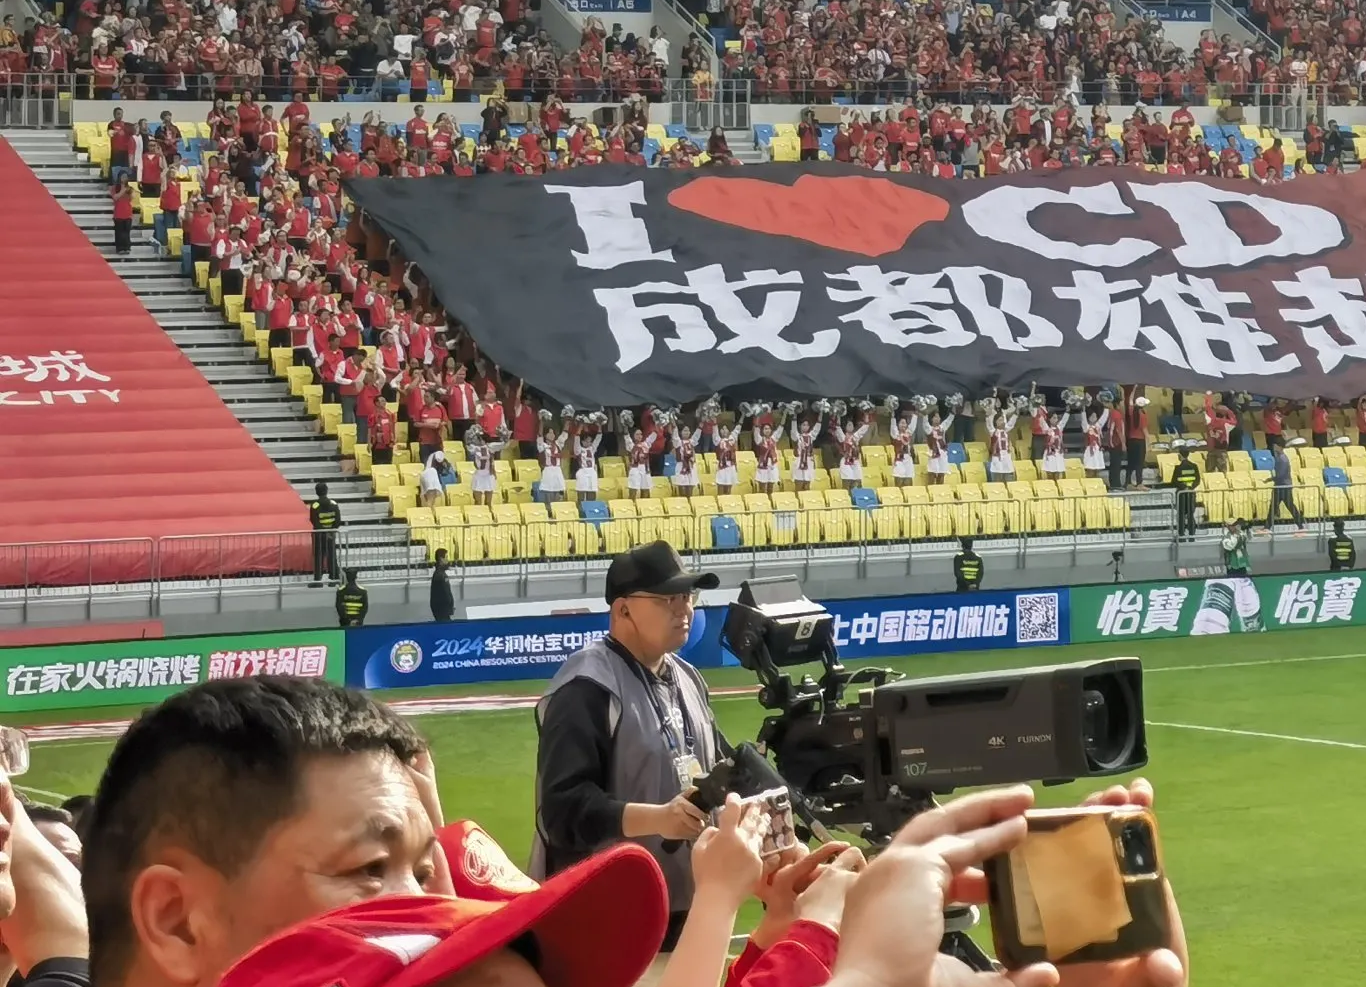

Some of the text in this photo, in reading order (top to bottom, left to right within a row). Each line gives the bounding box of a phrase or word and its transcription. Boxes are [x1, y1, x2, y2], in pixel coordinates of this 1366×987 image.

[544, 180, 1346, 270] I CD
[801, 621, 812, 636] 8
[6, 644, 328, 696] 在家火锅烧烤 就找锅圈
[454, 658, 480, 669] CHINA
[480, 656, 529, 667] RESOURCES
[988, 735, 1006, 747] 4K
[903, 762, 928, 778] 107
